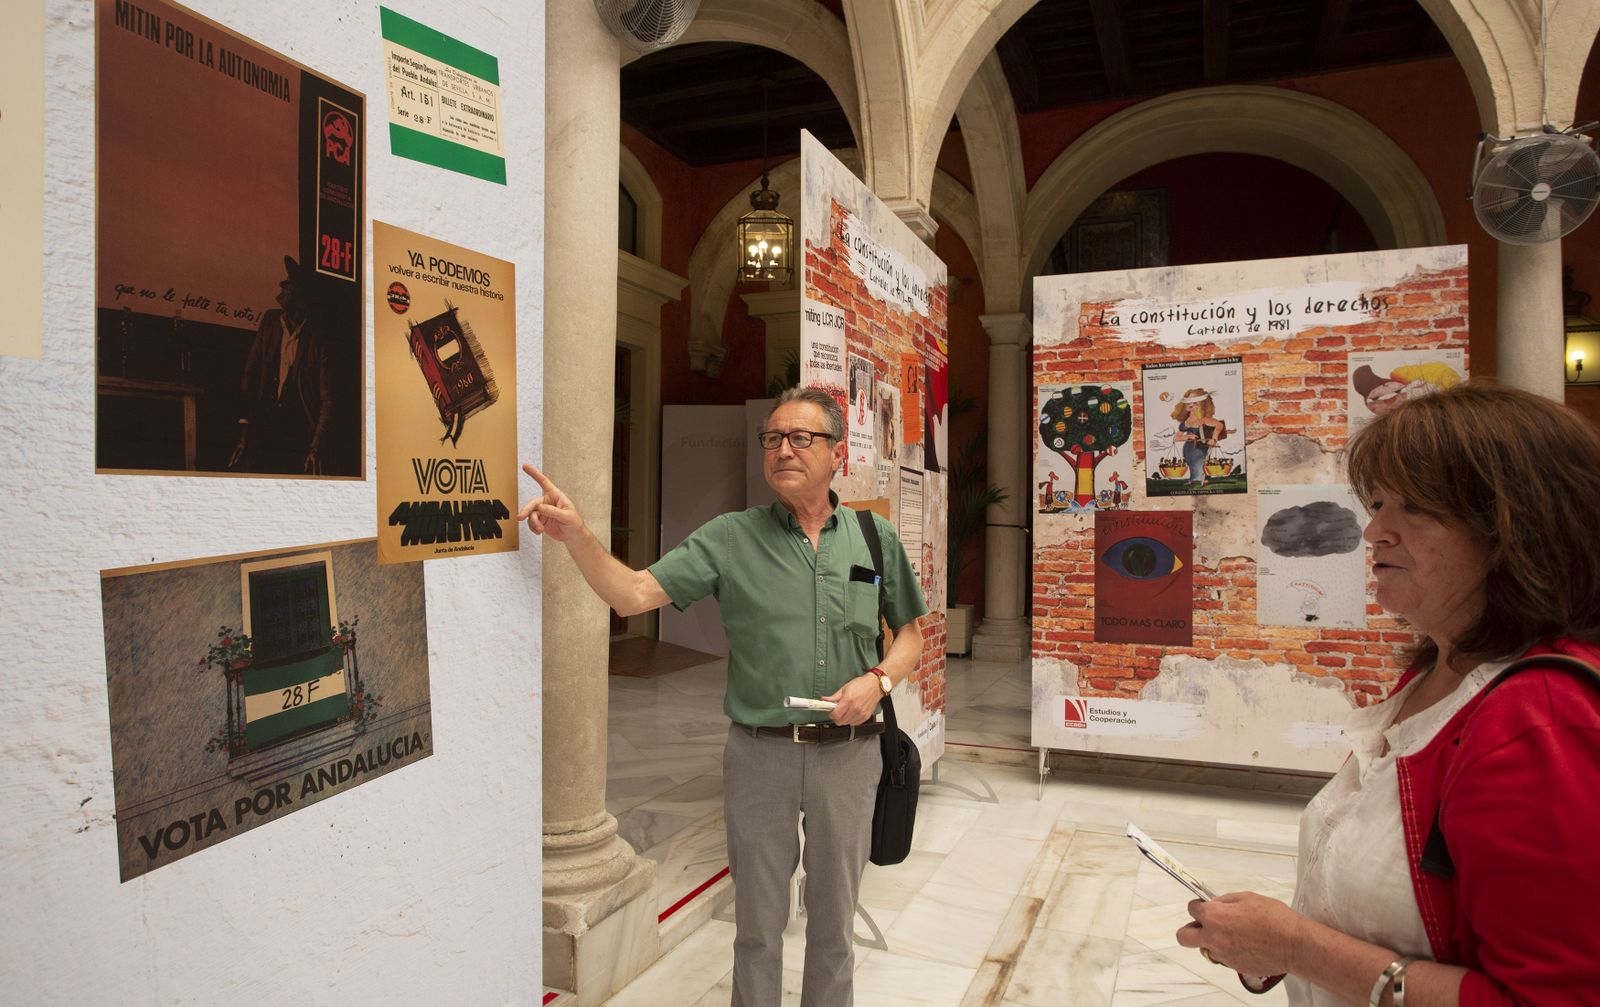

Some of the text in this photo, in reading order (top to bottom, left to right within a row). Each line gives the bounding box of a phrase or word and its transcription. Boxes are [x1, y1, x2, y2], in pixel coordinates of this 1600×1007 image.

[115, 0, 291, 103] MITIN POR LA AUTONOMIA
[392, 64, 438, 87] del Pueblo Andaluz
[400, 86, 434, 108] Art. 151
[397, 106, 409, 118] Serie
[442, 96, 494, 122] BILLETE EXTRAORDINARIO
[326, 140, 350, 166] PCA
[407, 249, 490, 287] YA PODEMOS
[854, 237, 894, 278] constitución
[139, 289, 156, 300] no
[162, 287, 176, 302] le
[388, 264, 504, 302] volver a escribir nuestra historia
[822, 312, 834, 327] LCR
[1098, 293, 1390, 327] La constitución y los derechos
[1187, 319, 1290, 336] Carteles de 1981
[412, 457, 489, 494] VOTA
[434, 546, 448, 554] Junta
[1100, 617, 1186, 629] TODO MAS CLARO
[1089, 708, 1121, 716] Estudios
[1089, 715, 1136, 724] Cooperación
[138, 731, 424, 860] VOTA POR ANDALUCIA
